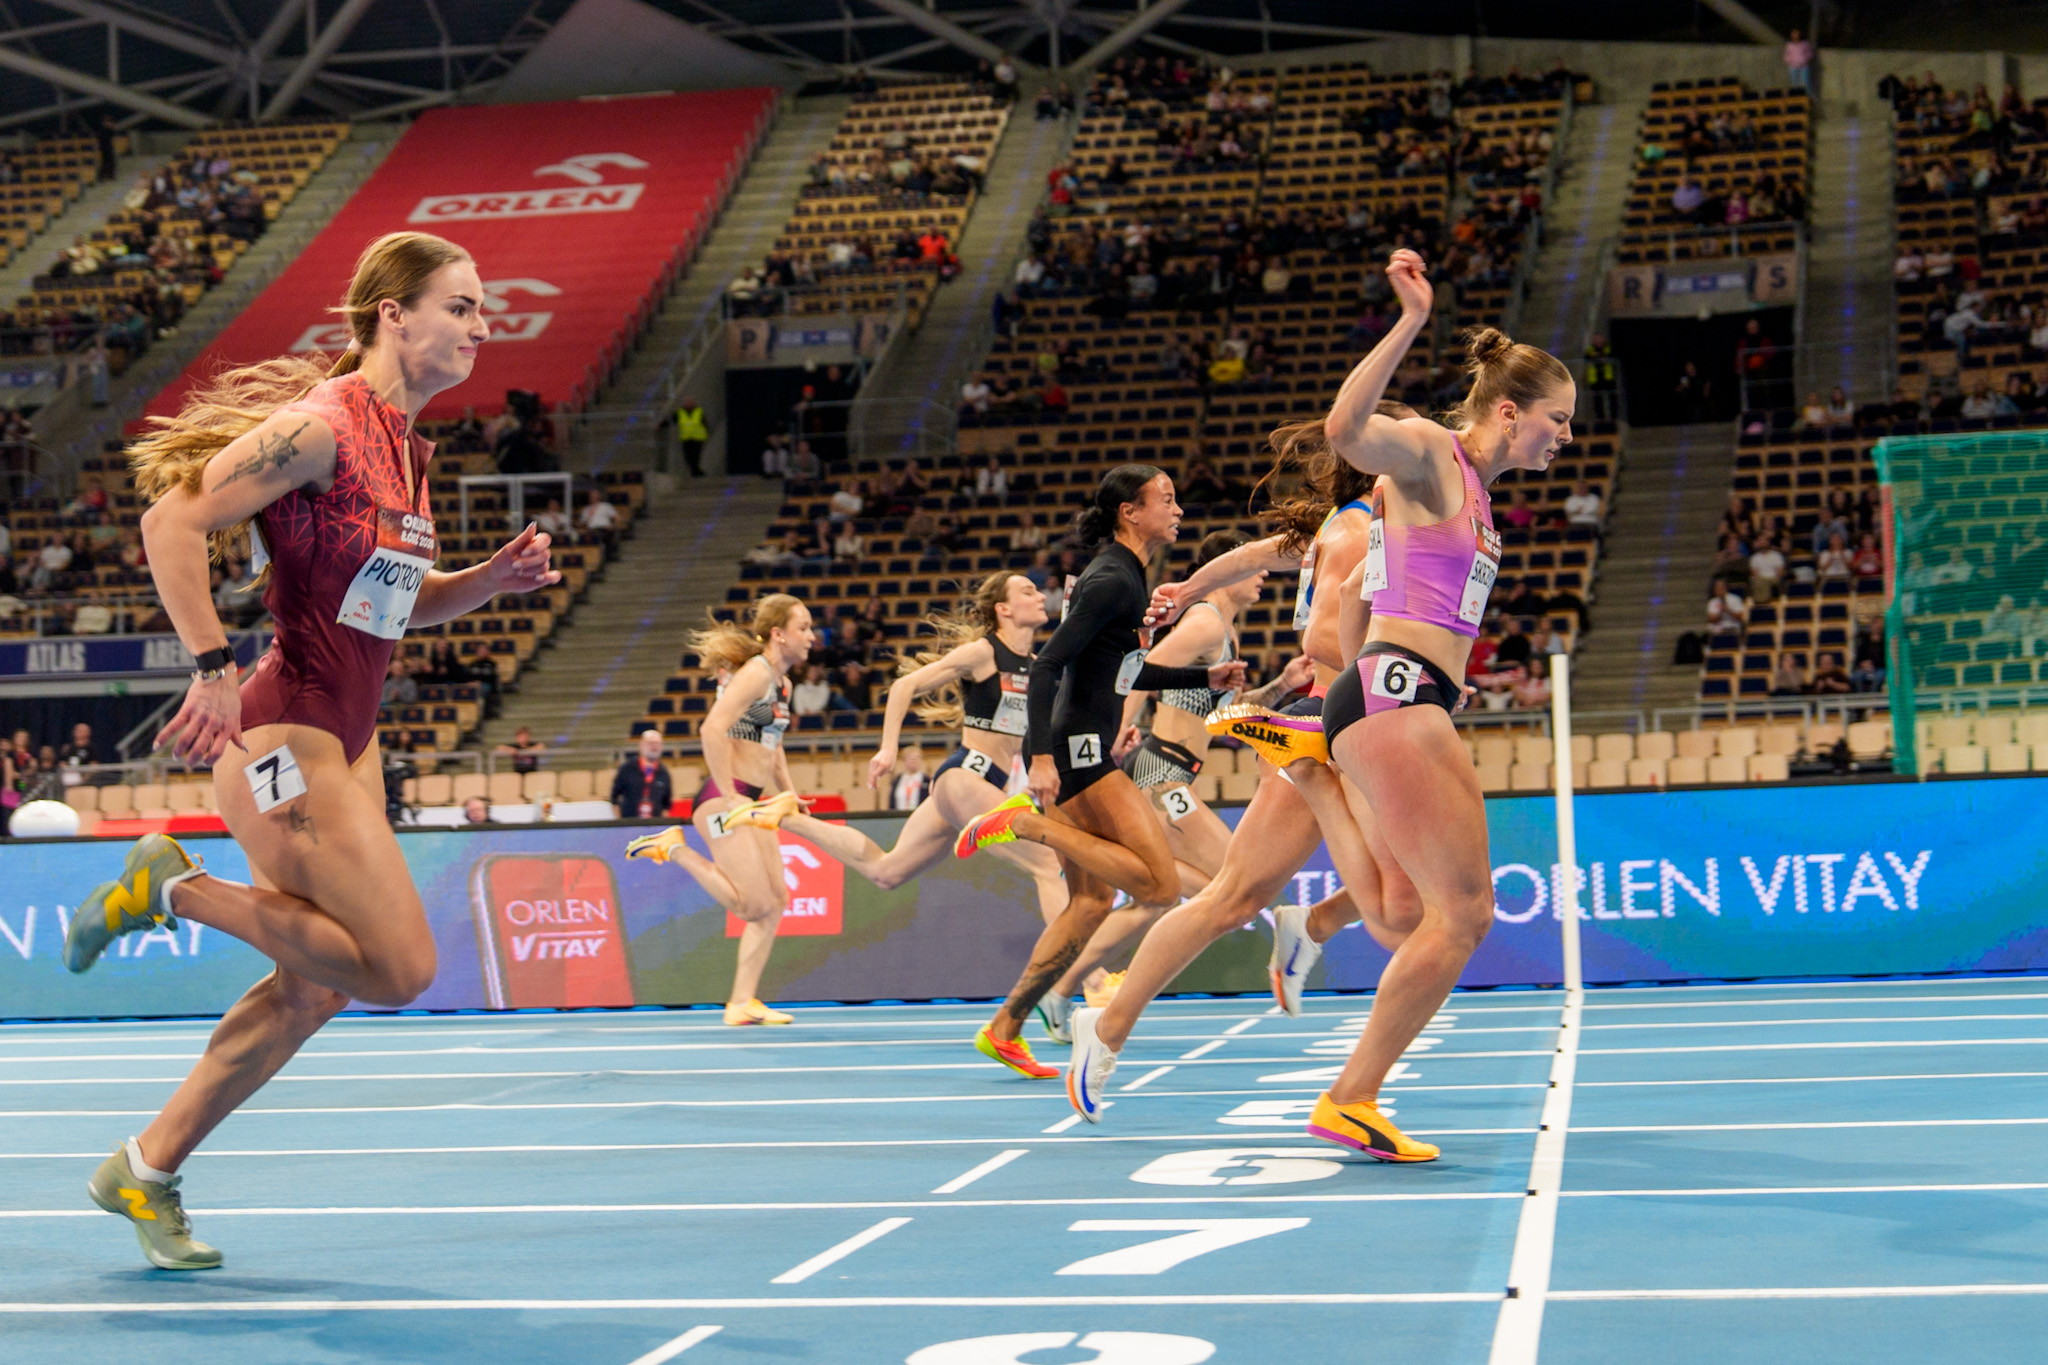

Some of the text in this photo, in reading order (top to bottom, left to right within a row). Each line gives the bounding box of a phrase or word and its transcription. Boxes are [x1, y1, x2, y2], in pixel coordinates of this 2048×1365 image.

[427, 189, 625, 216] ORLEN
[26, 642, 86, 672] ATLAS
[1383, 660, 1411, 695] 6
[1077, 737, 1095, 764] 4
[1231, 722, 1294, 749] NITRO
[255, 754, 281, 802] 7
[969, 754, 986, 773] 2
[1169, 791, 1189, 815] 3
[713, 815, 725, 835] 1
[1492, 849, 1933, 924] ORLEN VITAY
[505, 898, 610, 927] ORLEN
[511, 929, 612, 962] VITAY
[1215, 1097, 1398, 1127] 5
[1128, 1147, 1351, 1186] 6
[1053, 1217, 1312, 1276] 7
